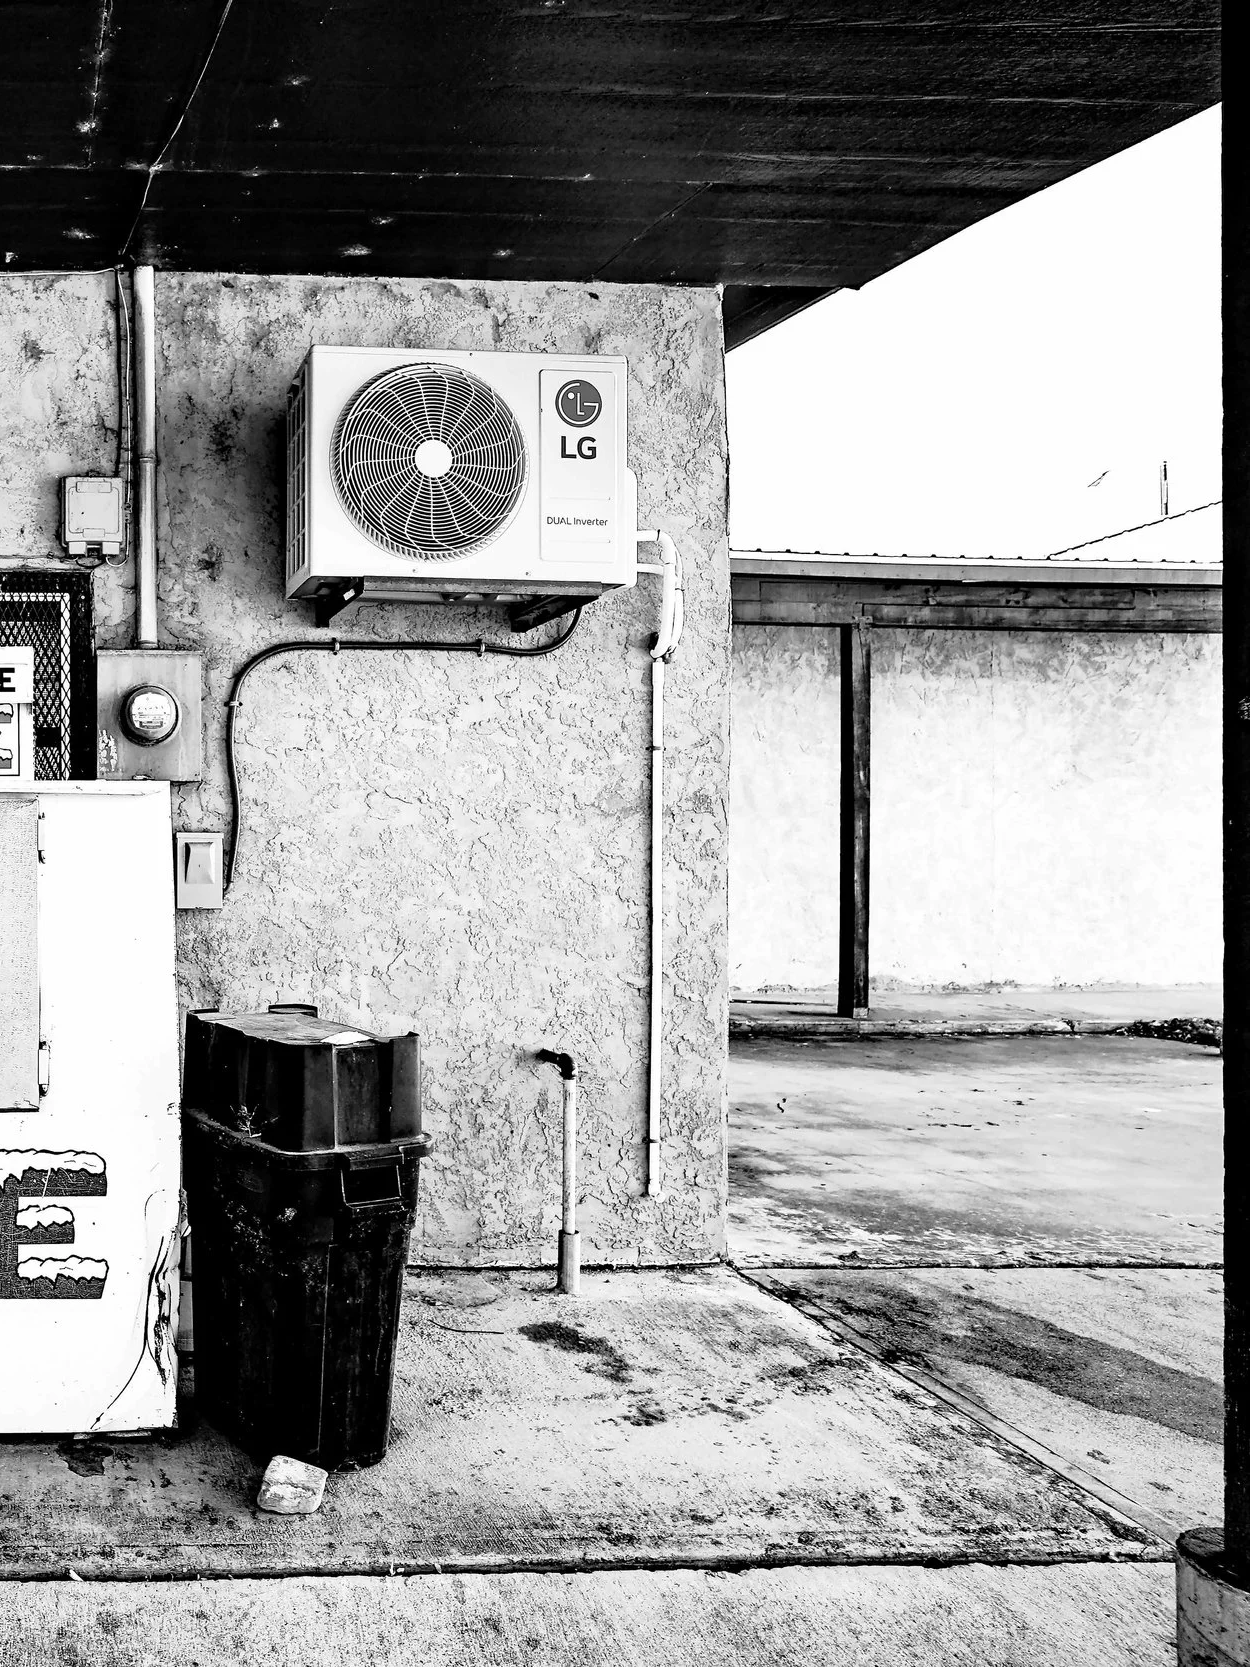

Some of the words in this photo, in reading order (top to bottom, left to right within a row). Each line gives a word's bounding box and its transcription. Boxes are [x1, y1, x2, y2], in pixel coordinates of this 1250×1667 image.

[560, 435, 597, 460] LG
[546, 516, 572, 526] DUAL
[573, 517, 609, 527] Inverter
